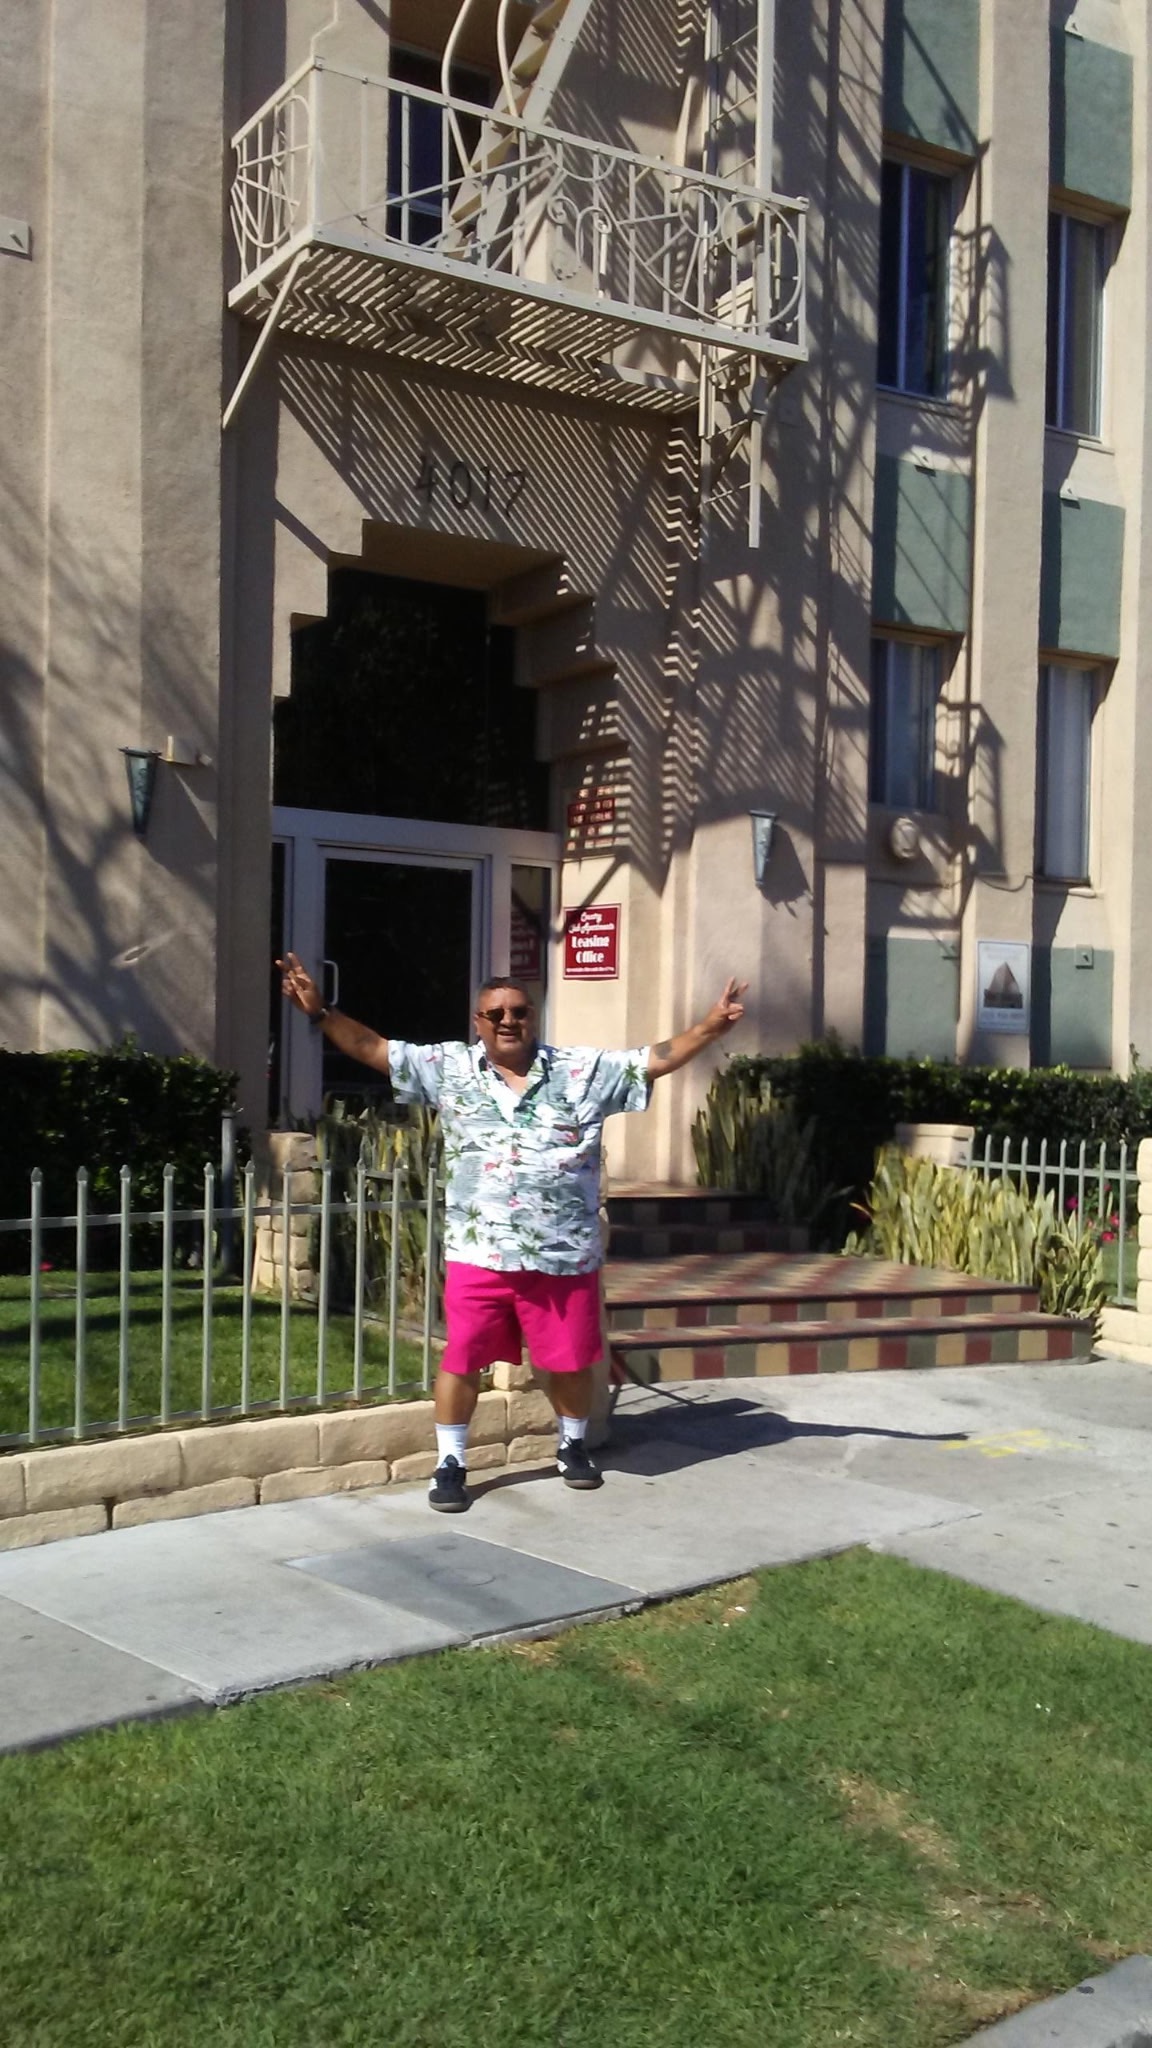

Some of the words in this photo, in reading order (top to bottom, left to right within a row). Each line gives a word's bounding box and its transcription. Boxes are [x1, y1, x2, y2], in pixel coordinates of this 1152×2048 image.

[415, 455, 526, 518] 4017
[571, 934, 610, 948] Leasing
[575, 950, 605, 963] Office
